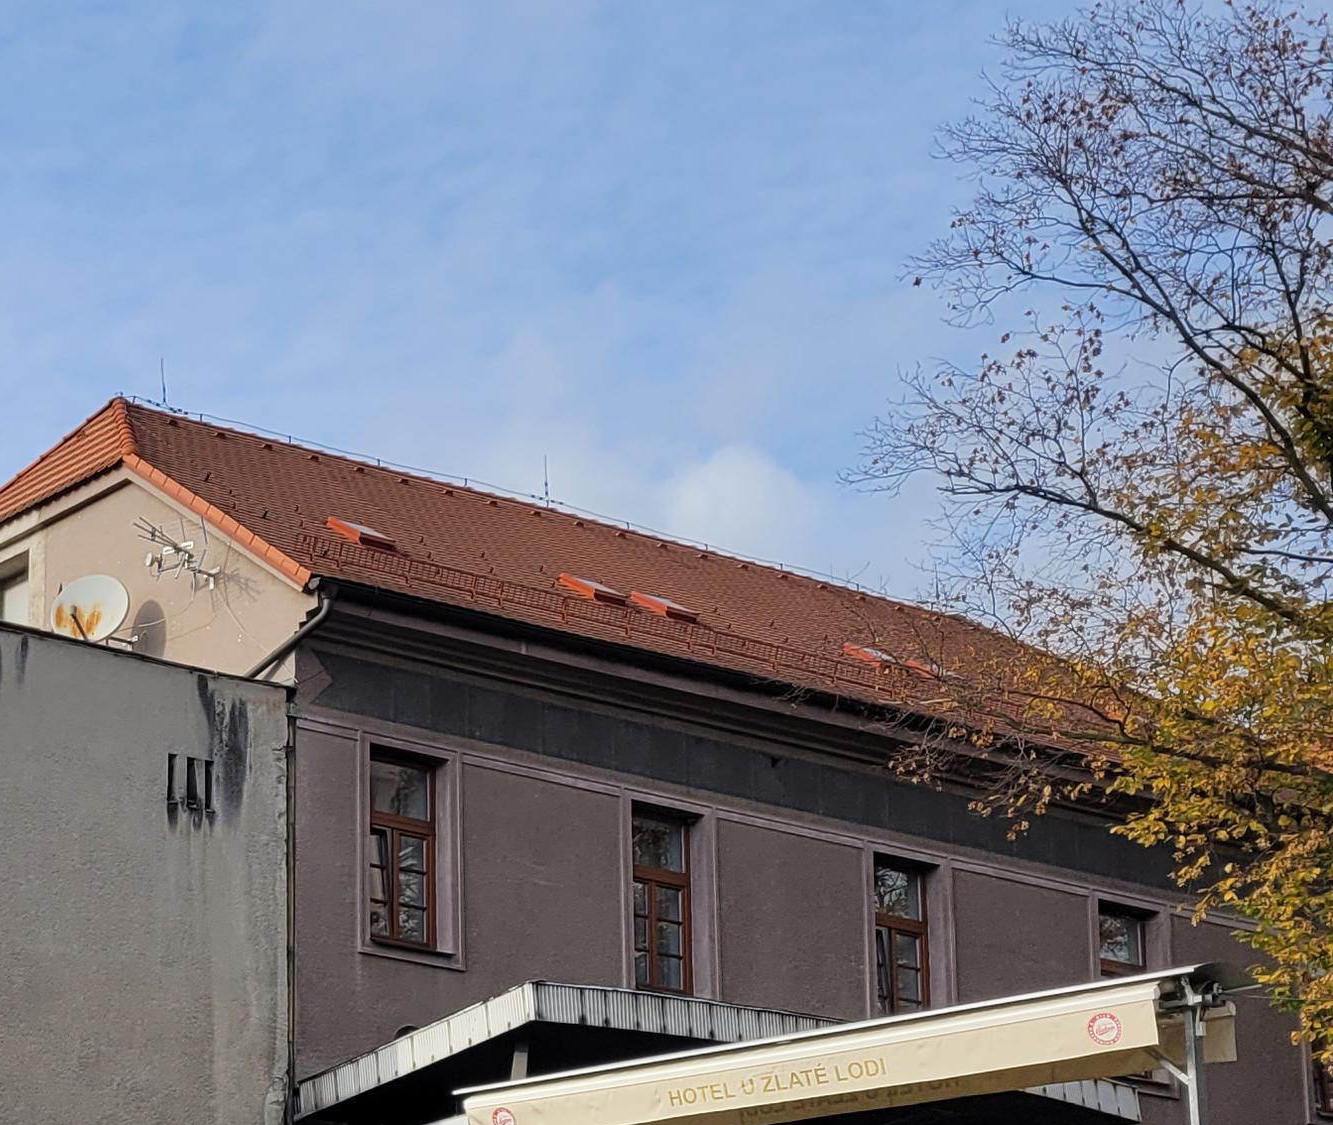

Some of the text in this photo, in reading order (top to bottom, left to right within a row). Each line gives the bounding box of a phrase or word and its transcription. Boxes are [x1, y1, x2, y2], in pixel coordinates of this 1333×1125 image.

[668, 1081, 737, 1107] HOTEL
[741, 1078, 755, 1095] U
[761, 1062, 830, 1093] ZLATÉ
[834, 1057, 886, 1082] LODI
